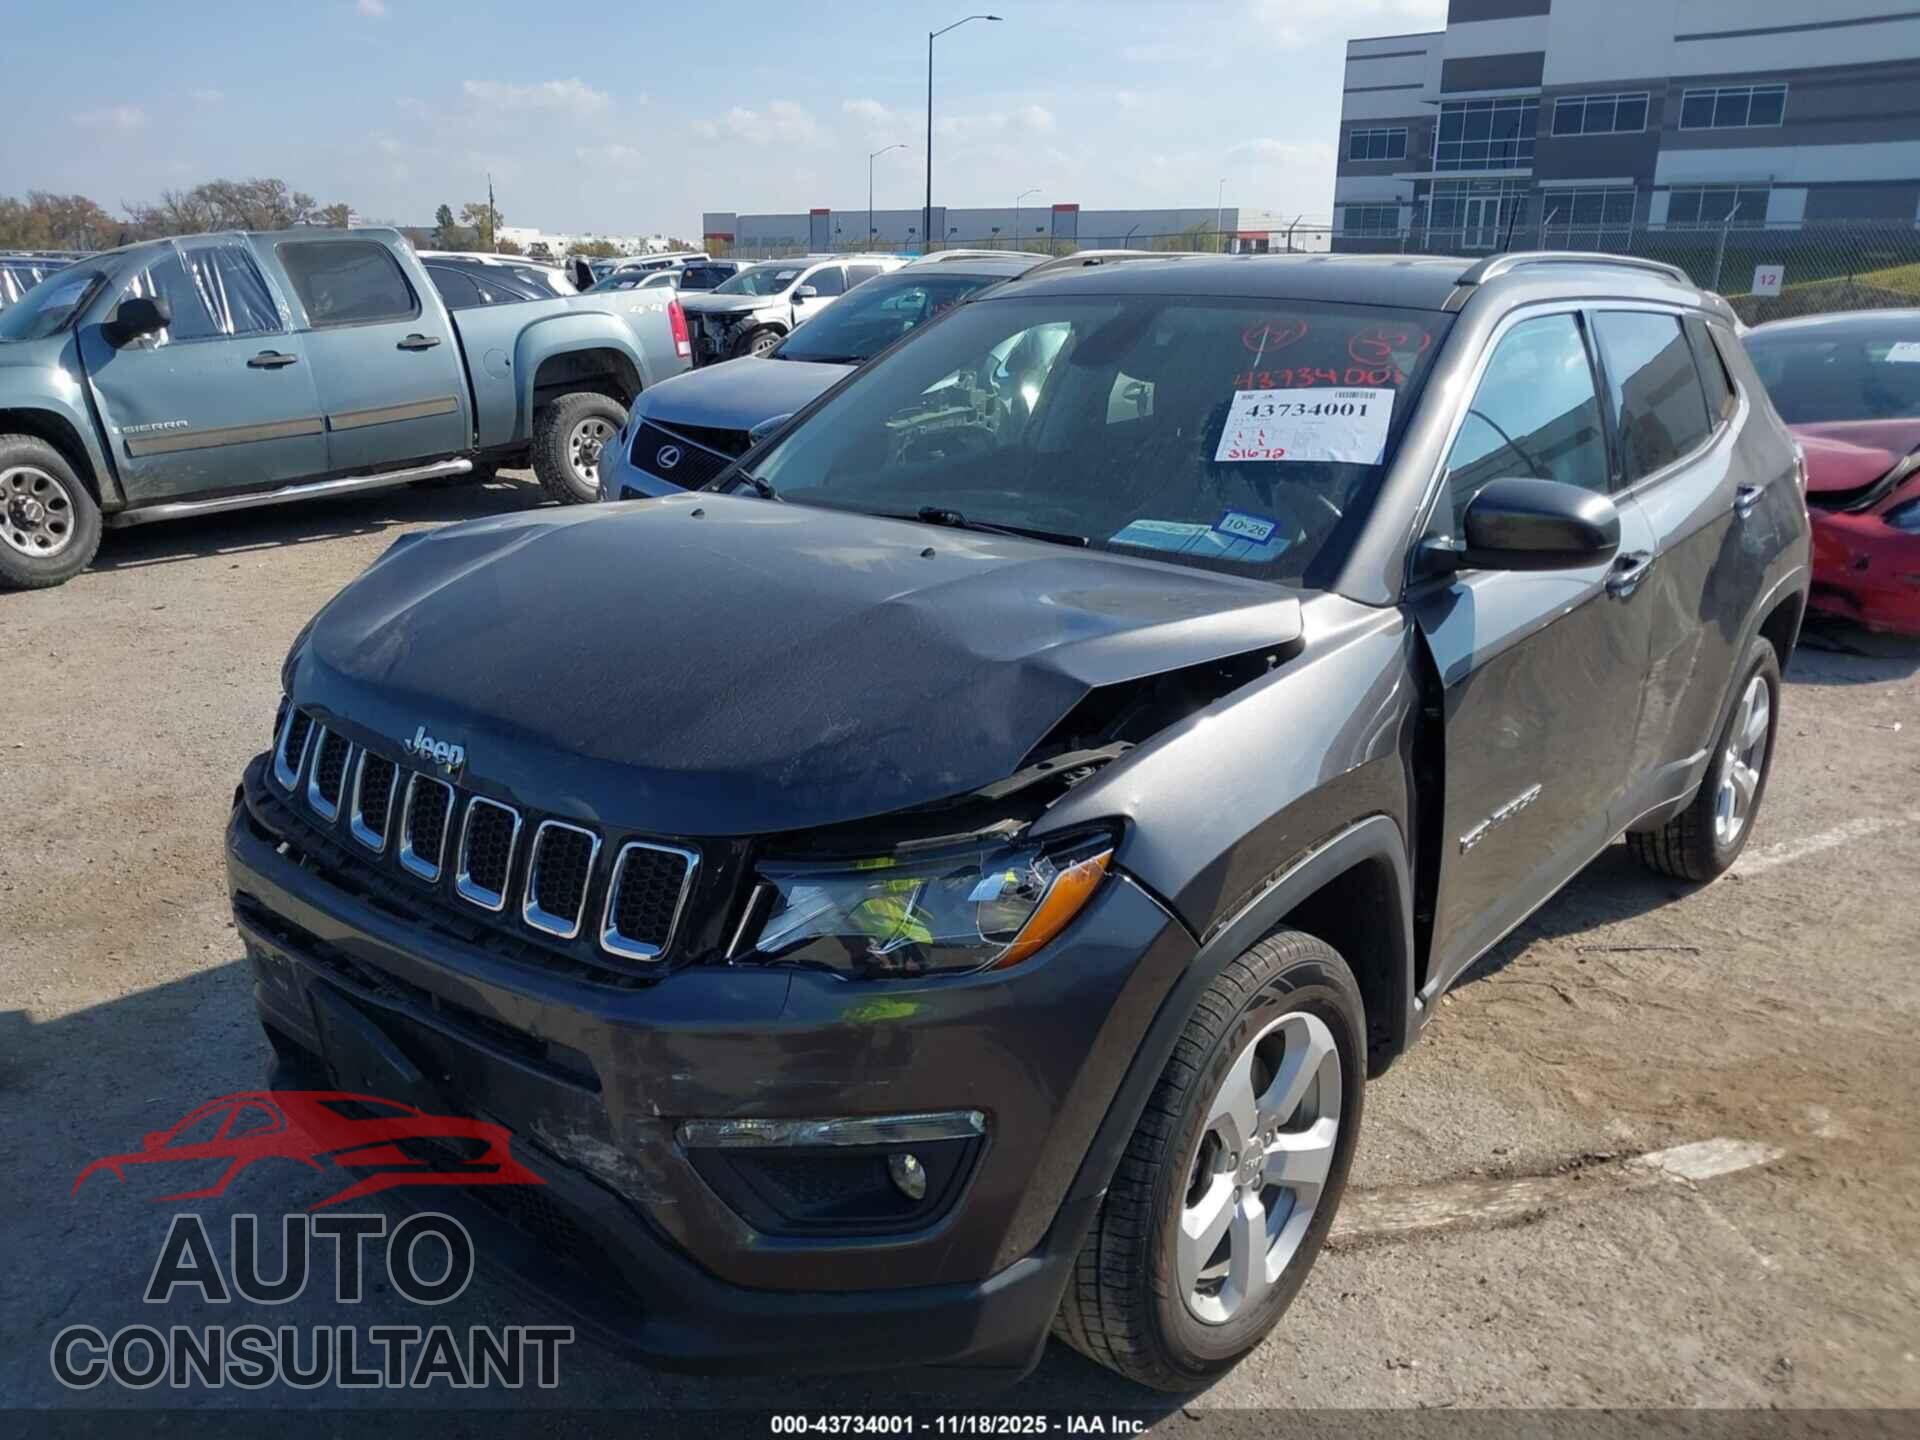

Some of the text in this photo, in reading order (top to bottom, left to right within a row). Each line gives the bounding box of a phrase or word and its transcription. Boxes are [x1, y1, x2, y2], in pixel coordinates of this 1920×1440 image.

[1760, 273, 1777, 286] 12
[1245, 403, 1368, 417] 43734001
[122, 419, 189, 434] SIERRA
[404, 726, 464, 774] Jeep
